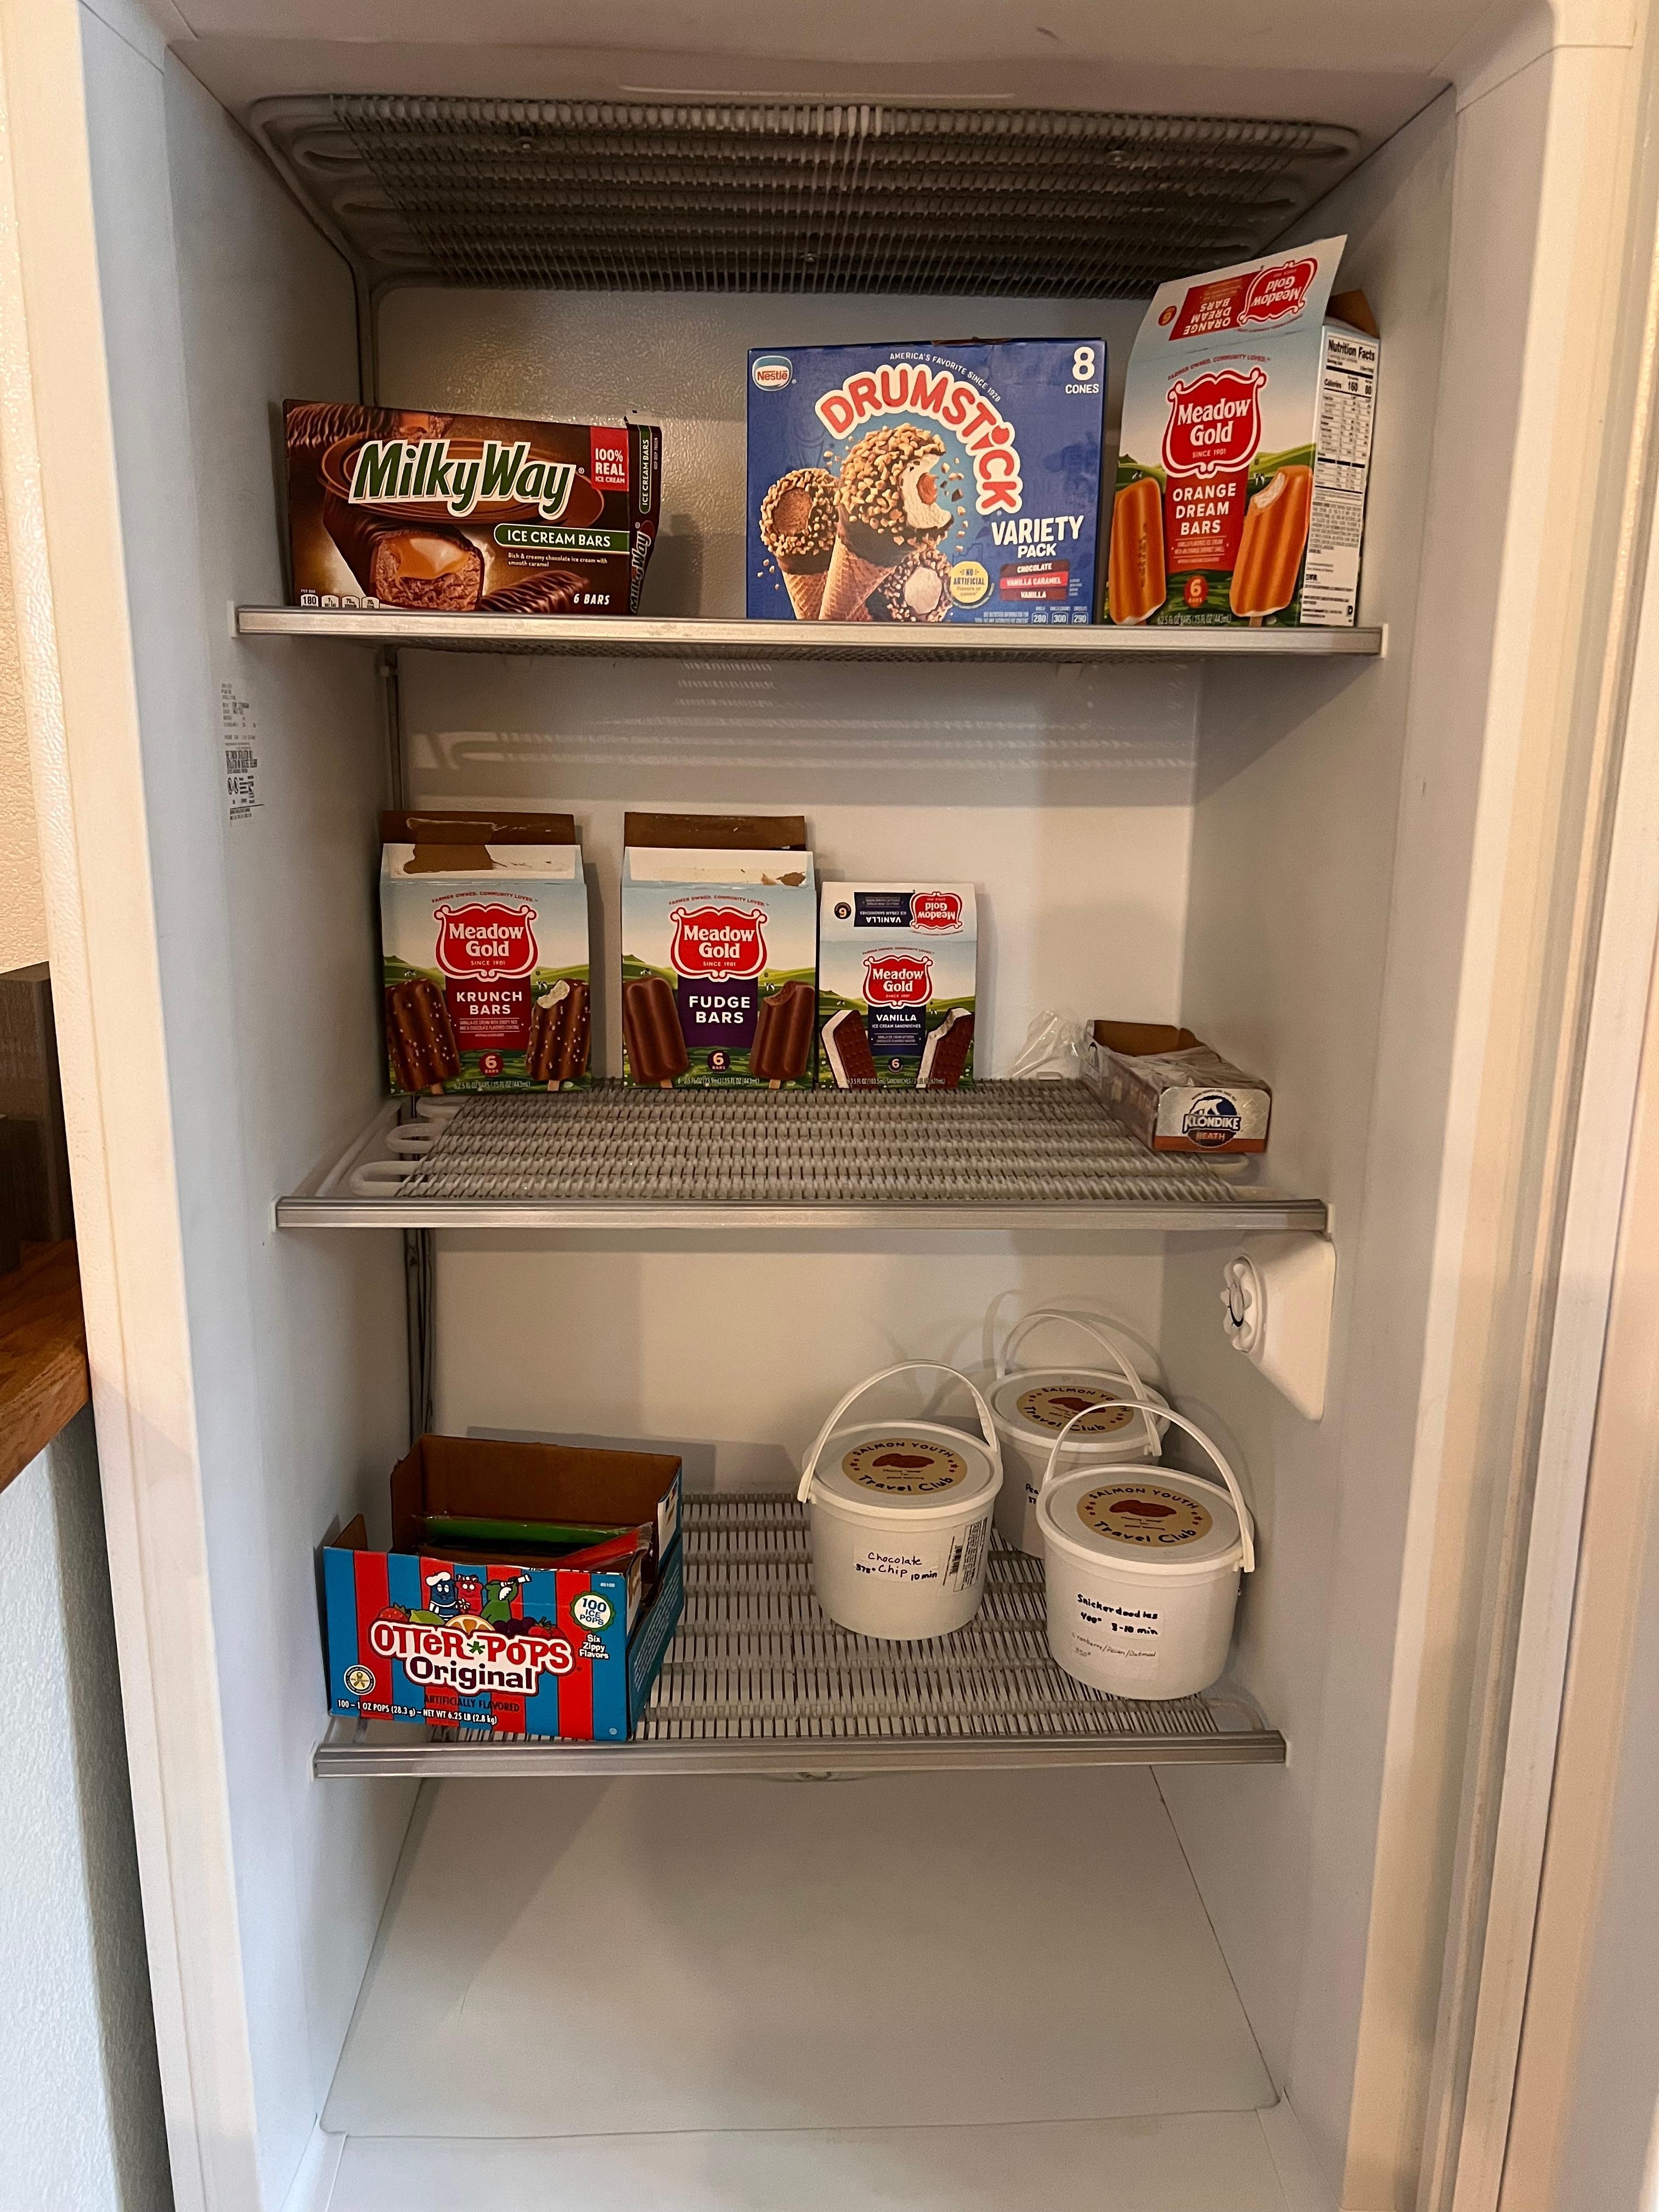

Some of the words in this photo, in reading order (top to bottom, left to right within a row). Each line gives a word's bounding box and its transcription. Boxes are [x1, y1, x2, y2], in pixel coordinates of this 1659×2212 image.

[1265, 275, 1296, 293] Gold
[1251, 287, 1302, 307] Meadow
[1200, 297, 1231, 313] BARS
[1190, 306, 1232, 324] DREAM
[1183, 317, 1231, 336] ORANGE
[1328, 340, 1356, 356] Nutrition
[1358, 347, 1375, 361] Facts
[890, 352, 931, 362] AMERICA'S
[932, 356, 967, 375] FAVORITE
[967, 370, 988, 390] SINCE
[1071, 347, 1095, 381] 8
[1065, 383, 1099, 394] CONES
[1348, 381, 1358, 392] 160
[1177, 398, 1251, 425] Meadow
[1190, 421, 1233, 446] Gold
[595, 448, 623, 462] 100%
[1192, 449, 1211, 458] SINCE
[595, 462, 625, 476] REAL
[1172, 483, 1237, 501] ORANGE
[1176, 501, 1229, 519] DREAM
[991, 515, 1084, 546] VARIETY
[1181, 520, 1221, 535] BARS
[507, 530, 527, 541] ICE
[531, 532, 575, 545] CREAM
[579, 534, 611, 547] BARS
[1018, 543, 1056, 558] PACK
[1017, 563, 1052, 573] CHOCOLATE
[1006, 577, 1031, 586] VANILLA
[1032, 577, 1061, 585] CARAMEL
[1190, 579, 1201, 596] 6
[574, 594, 580, 603] 6
[584, 594, 610, 605] BARS
[1053, 614, 1066, 623] 300
[1074, 614, 1087, 623] 290
[925, 902, 947, 911] Gold
[918, 911, 956, 920] Meadow
[449, 923, 524, 939] Meadow
[684, 925, 755, 941] Meadow
[466, 940, 509, 957] Gold
[698, 943, 741, 958] Gold
[872, 968, 924, 980] Meadow
[883, 980, 913, 992] Gold
[456, 991, 522, 1002] KRUNCH
[689, 996, 751, 1008] FUDGE
[470, 1005, 511, 1014] BARS
[696, 1012, 743, 1023] BARS
[485, 1056, 497, 1069] 6
[713, 1052, 724, 1065] 6
[891, 1058, 900, 1068] 6
[1183, 1115, 1240, 1132] KLONDIKE
[1101, 1393, 1130, 1412] YOH
[1023, 1406, 1062, 1427] Travel
[853, 1442, 905, 1455] SALMON
[912, 1442, 954, 1457] YOUTH
[859, 1475, 912, 1491] Travel
[918, 1477, 953, 1491] Club
[1088, 1488, 1146, 1499] SALMON
[1153, 1489, 1198, 1509] YOUTH
[1094, 1521, 1150, 1542] Travel
[1158, 1530, 1197, 1543] Club
[868, 1552, 922, 1565] Chocolate
[878, 1565, 907, 1577] Chip
[922, 1571, 938, 1579] min
[583, 1598, 607, 1613] 100
[579, 1614, 604, 1625] POPS
[585, 1609, 601, 1618] ICE
[587, 1634, 601, 1643] Six
[1137, 1627, 1158, 1635] min
[579, 1649, 609, 1659] Flavors
[583, 1642, 605, 1653] Zippy
[409, 1656, 533, 1689] Original
[425, 1695, 476, 1708] ARTIFICIALLY
[479, 1700, 520, 1712] FLAVORED
[338, 1700, 349, 1708] 100
[363, 1702, 371, 1711] OZ
[373, 1703, 390, 1712] POPS
[391, 1706, 407, 1714] (28.3
[409, 1708, 415, 1717] g)
[448, 1712, 462, 1720] 6.25
[473, 1714, 486, 1723] (2.8
[487, 1715, 497, 1725] kg)
